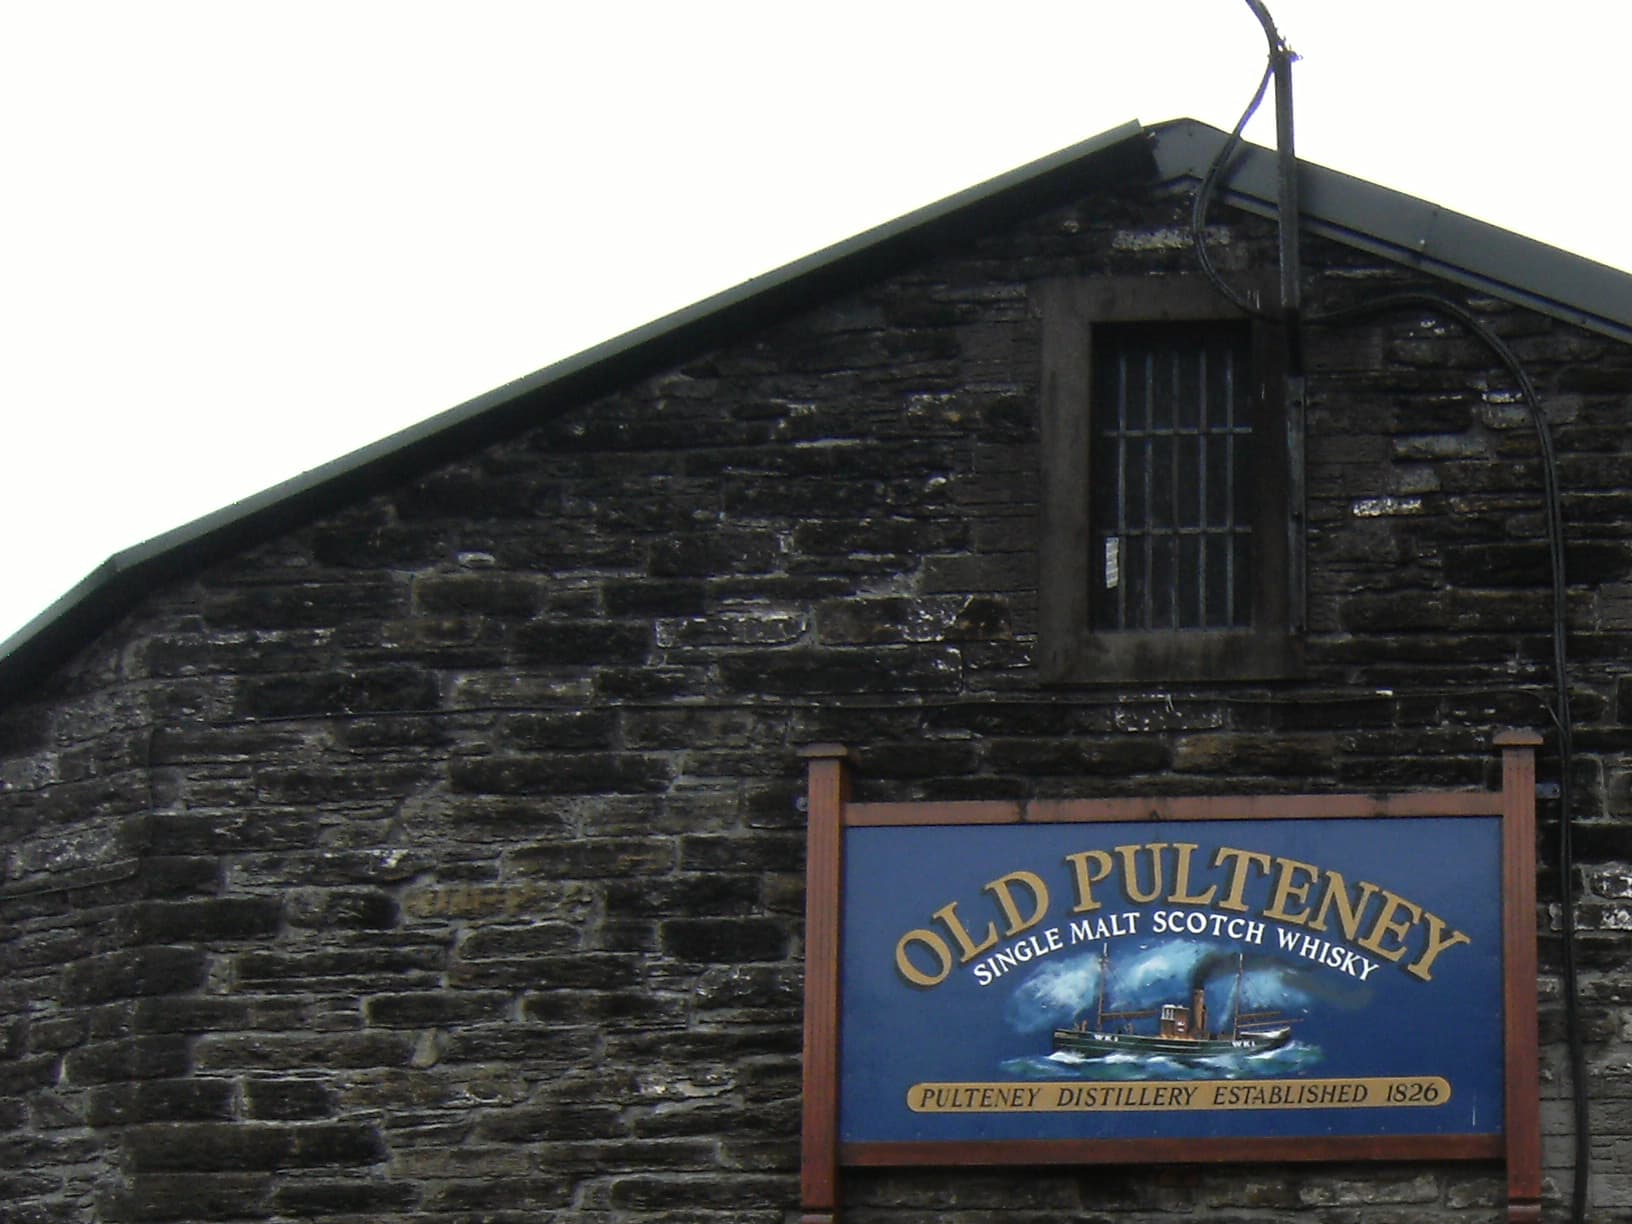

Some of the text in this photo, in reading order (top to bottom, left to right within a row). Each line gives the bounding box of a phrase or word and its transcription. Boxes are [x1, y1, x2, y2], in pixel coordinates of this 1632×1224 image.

[894, 842, 1471, 987] OLD PULTENEY
[973, 910, 1379, 987] SINGLE MALT SCOTCH WHISKY
[920, 1082, 1439, 1107] PULTENEY DISTILLERY ESTABLISHED 1826
